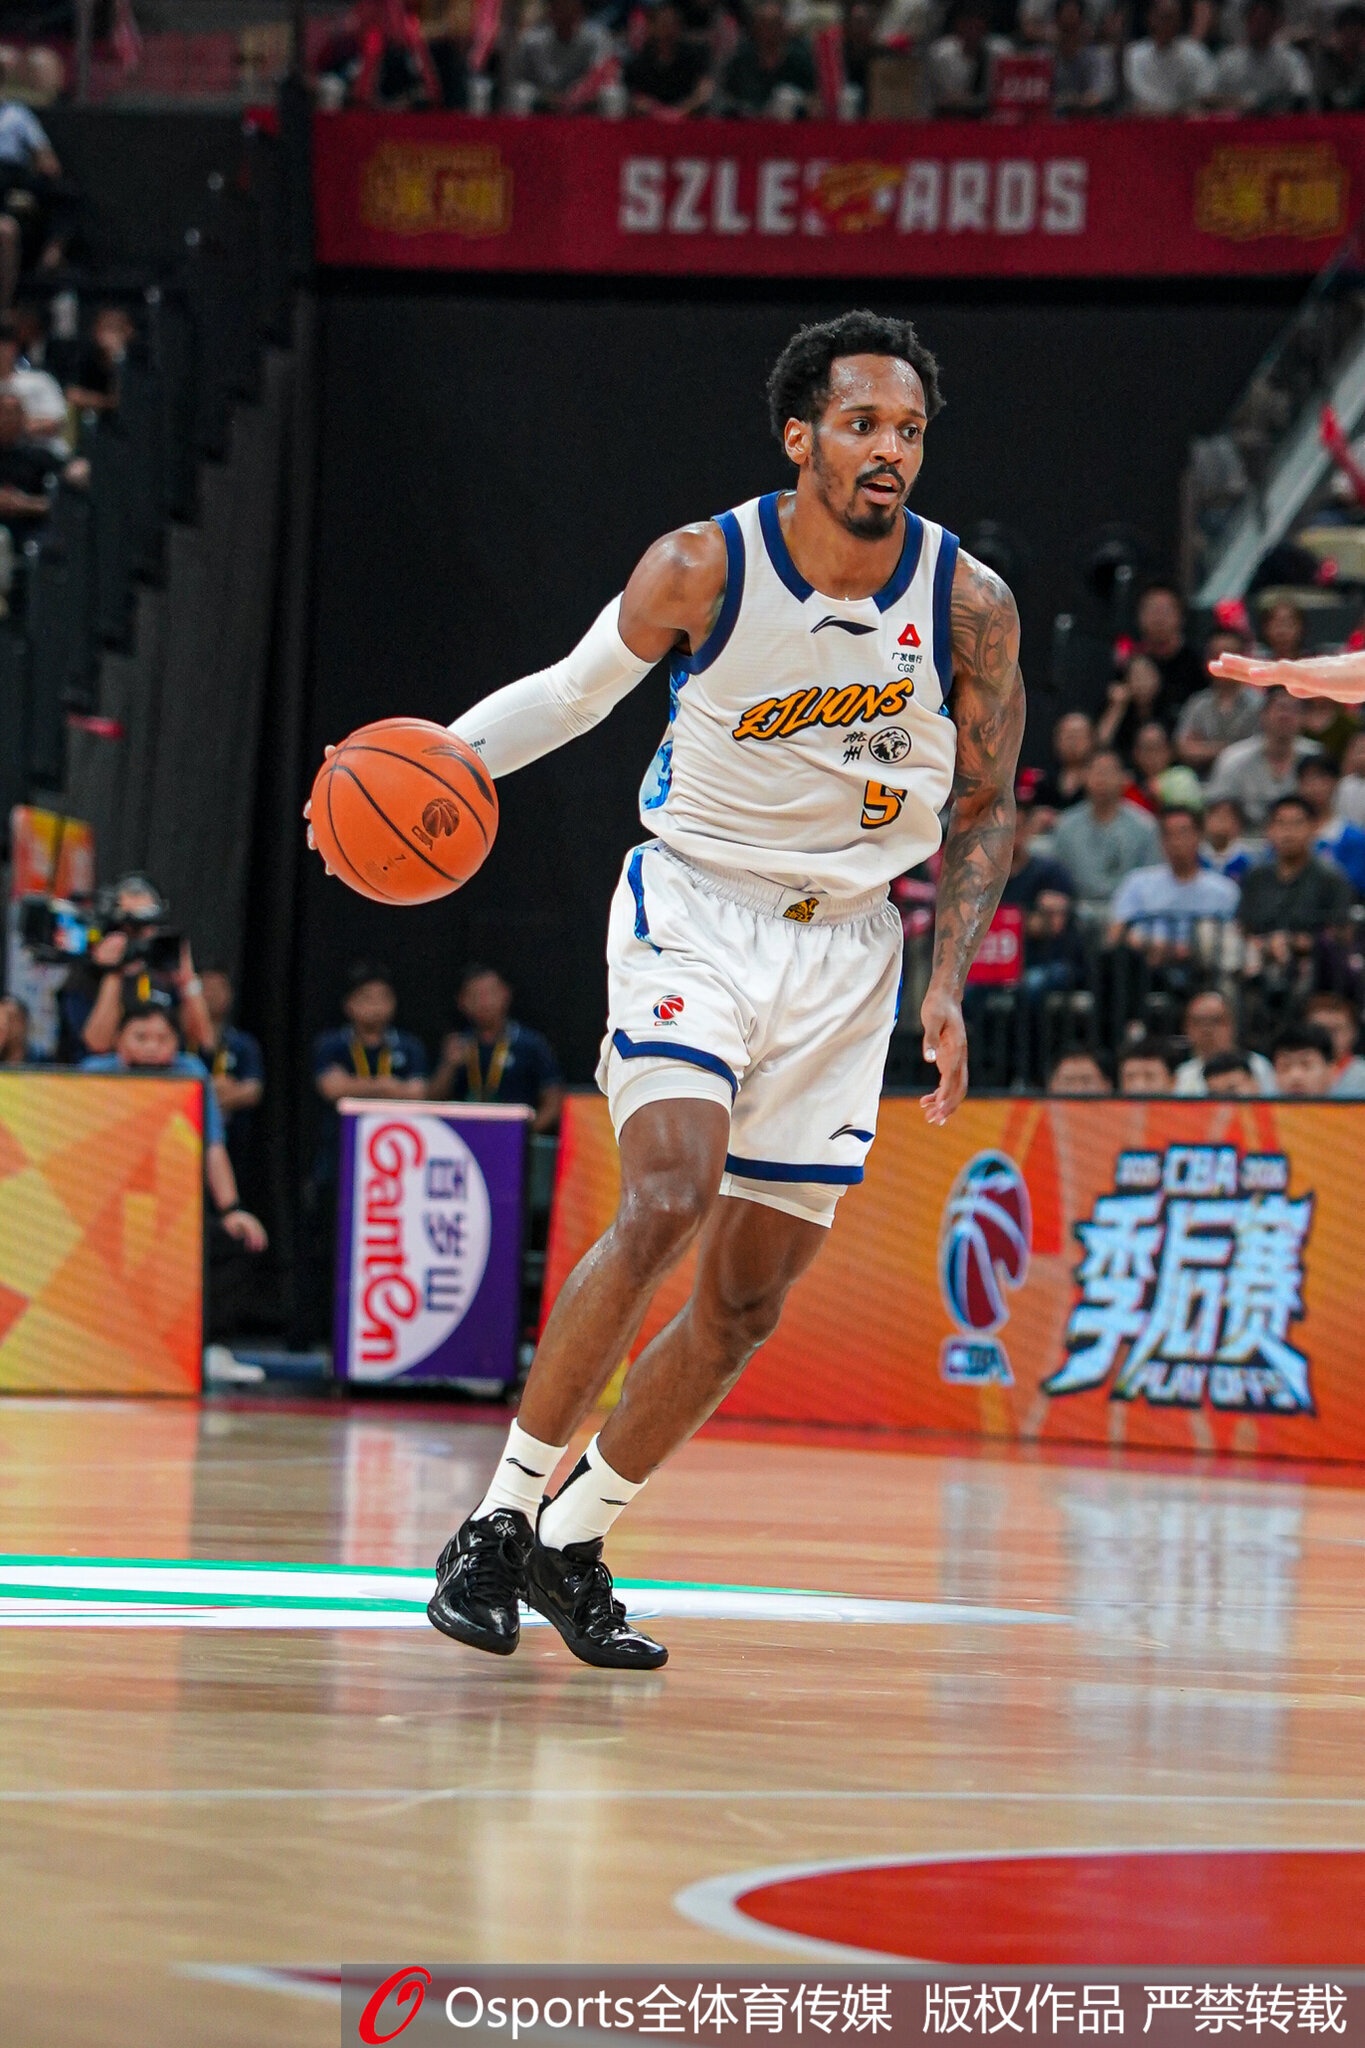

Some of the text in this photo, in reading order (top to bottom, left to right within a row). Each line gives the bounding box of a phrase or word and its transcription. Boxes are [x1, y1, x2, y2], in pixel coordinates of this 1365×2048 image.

[620, 156, 1086, 235] SZLEARDS
[891, 651, 923, 664] 广发银行
[897, 663, 915, 673] CGB
[860, 780, 907, 829] 5
[425, 1155, 468, 1312] 百岁山
[1043, 1193, 1315, 1412] 季后赛
